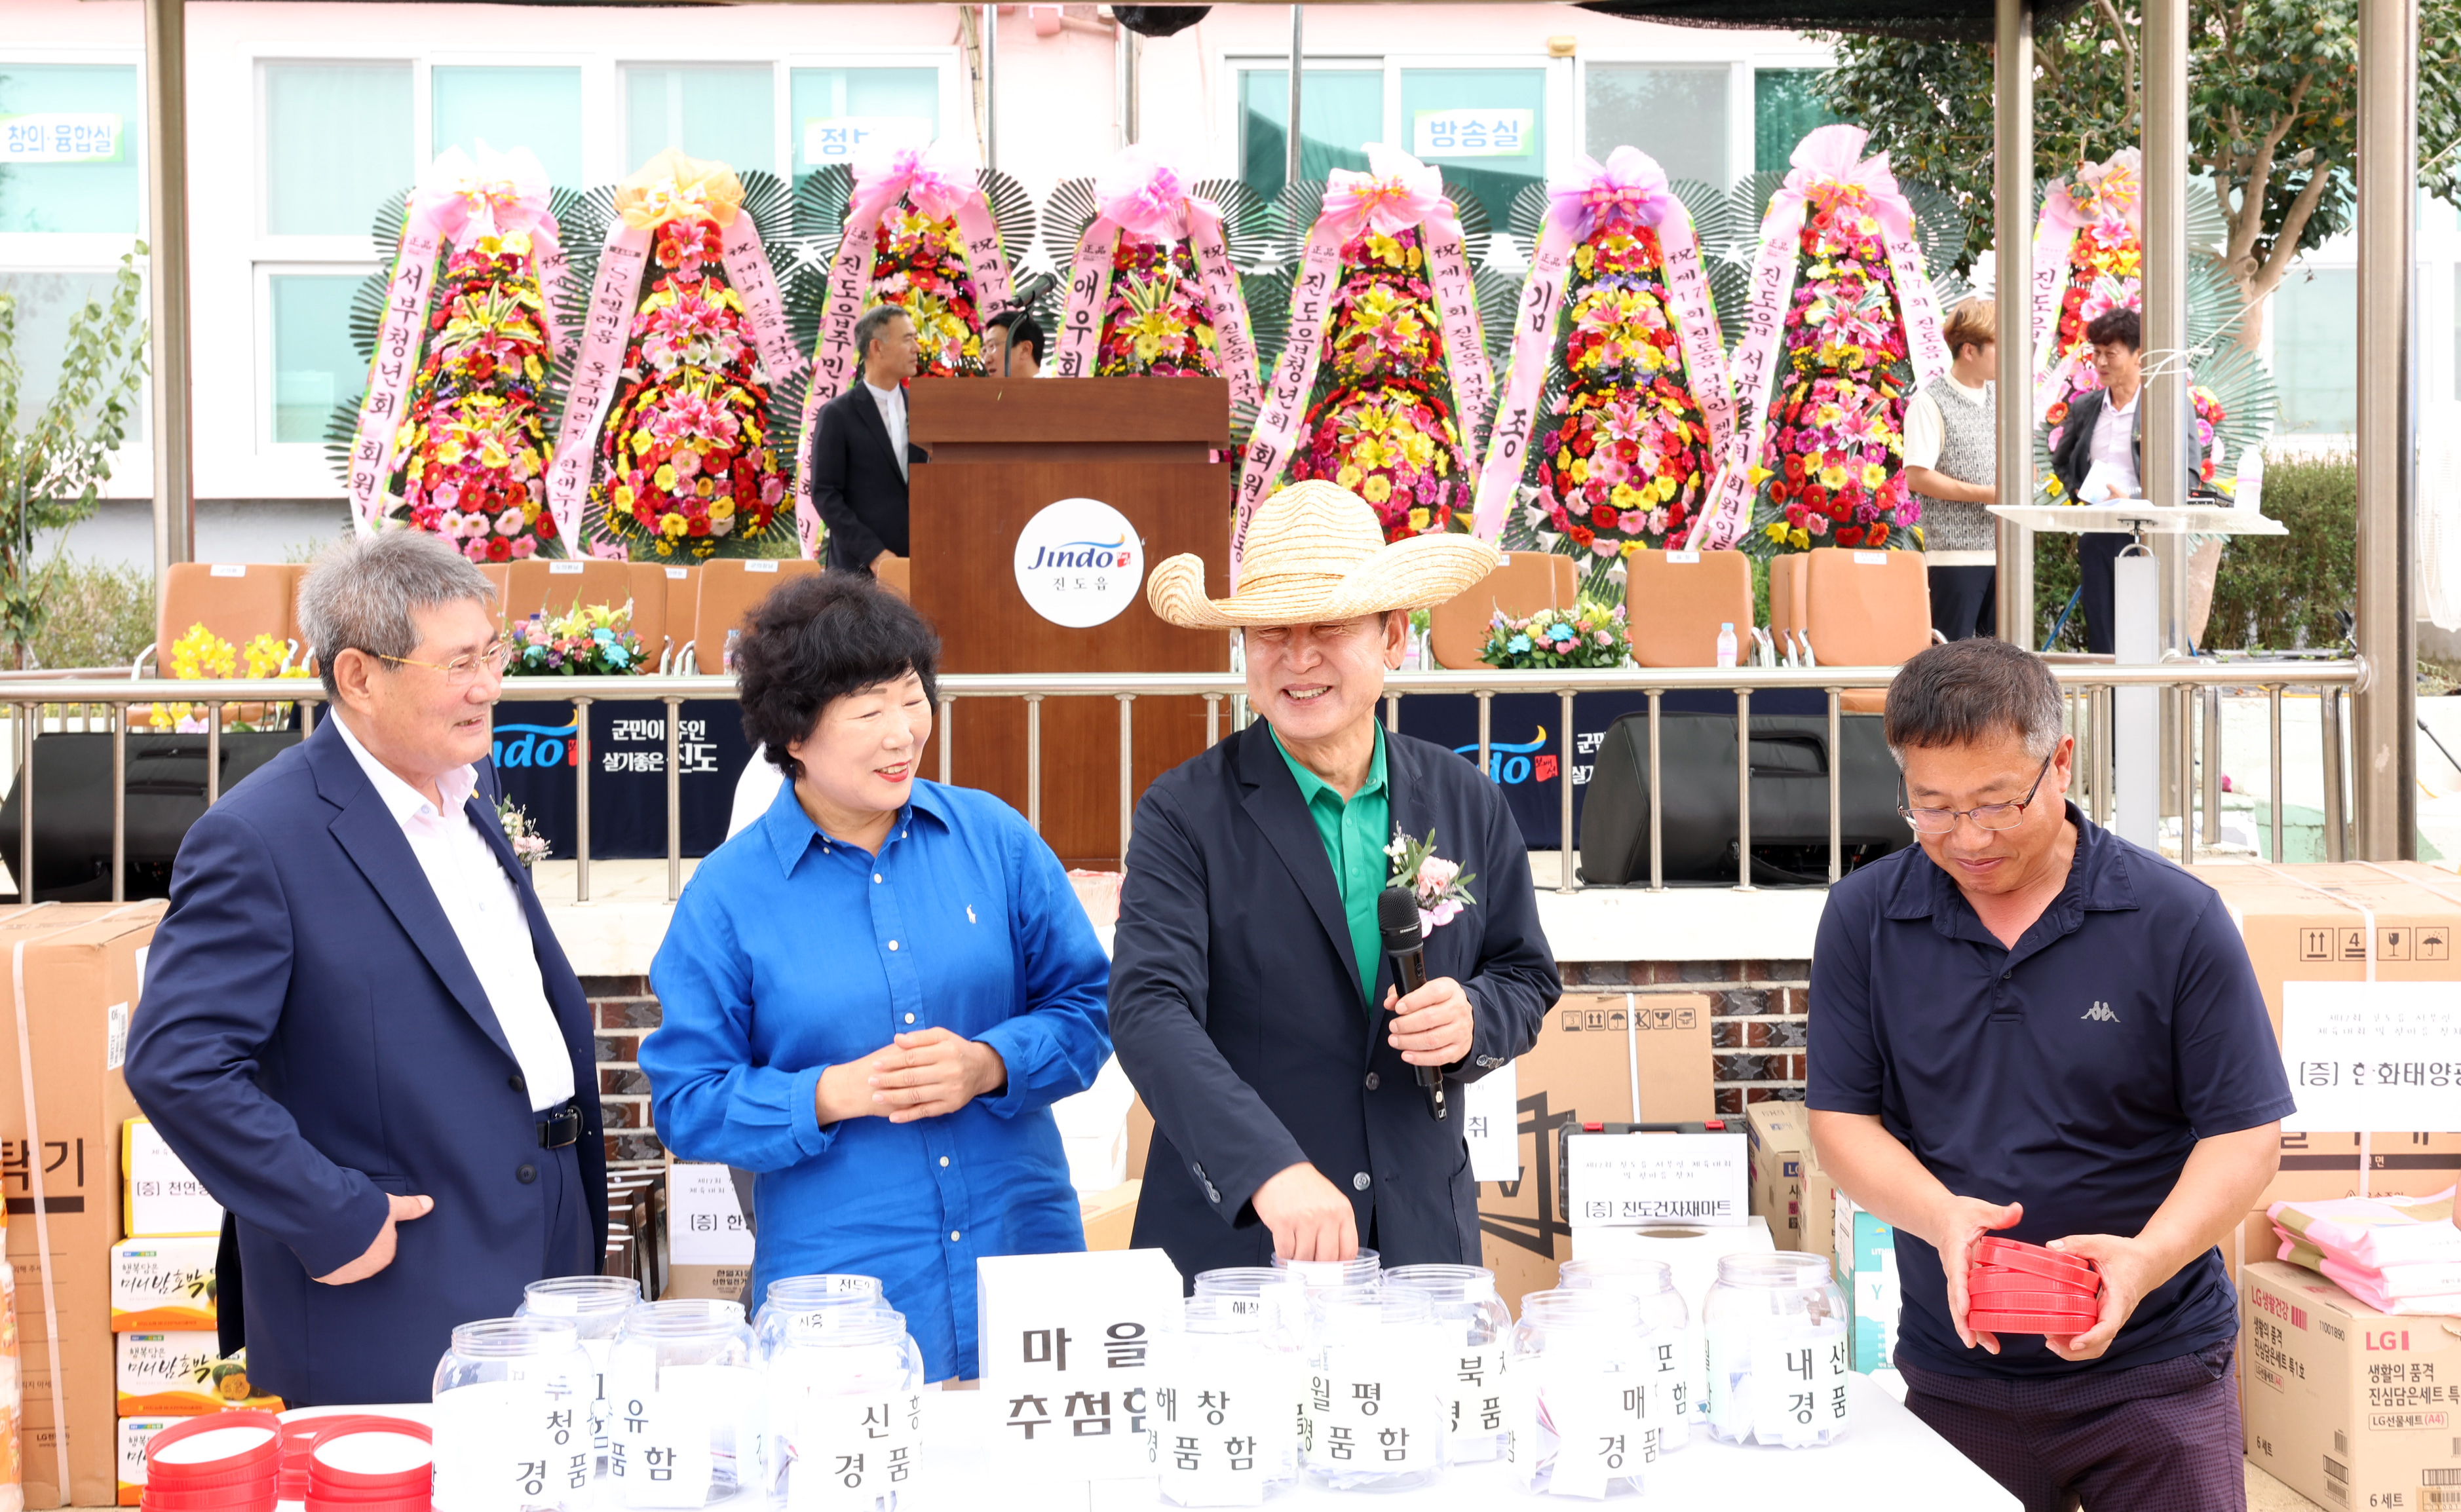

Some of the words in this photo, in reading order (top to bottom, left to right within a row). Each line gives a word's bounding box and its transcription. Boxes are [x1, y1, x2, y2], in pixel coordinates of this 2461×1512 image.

[8, 124, 111, 153] 창의·융합실
[1430, 120, 1518, 147] 방송실
[970, 238, 998, 254] 祝
[1082, 244, 1107, 255] 正品
[1201, 244, 1226, 259] 祝
[1312, 245, 1335, 257] 正品
[1433, 243, 1461, 259] 祝
[1668, 248, 1696, 264] 祝
[1751, 265, 1781, 337] 진도읍
[1057, 269, 1099, 378] 애우회
[1027, 546, 1114, 570] Jindo
[611, 719, 664, 741] 군민이
[602, 751, 664, 772] 살기좋은
[2348, 932, 2360, 947] 4
[1622, 1200, 1732, 1218] 진도건자재마트
[2319, 1319, 2345, 1342] 11001890
[2365, 1331, 2397, 1351] LG
[2368, 1363, 2405, 1384] 생활의
[2409, 1363, 2435, 1383] 품격
[2369, 1386, 2445, 1407] 진심담은세트
[2369, 1493, 2378, 1507] 6
[2381, 1492, 2404, 1509] 세트
